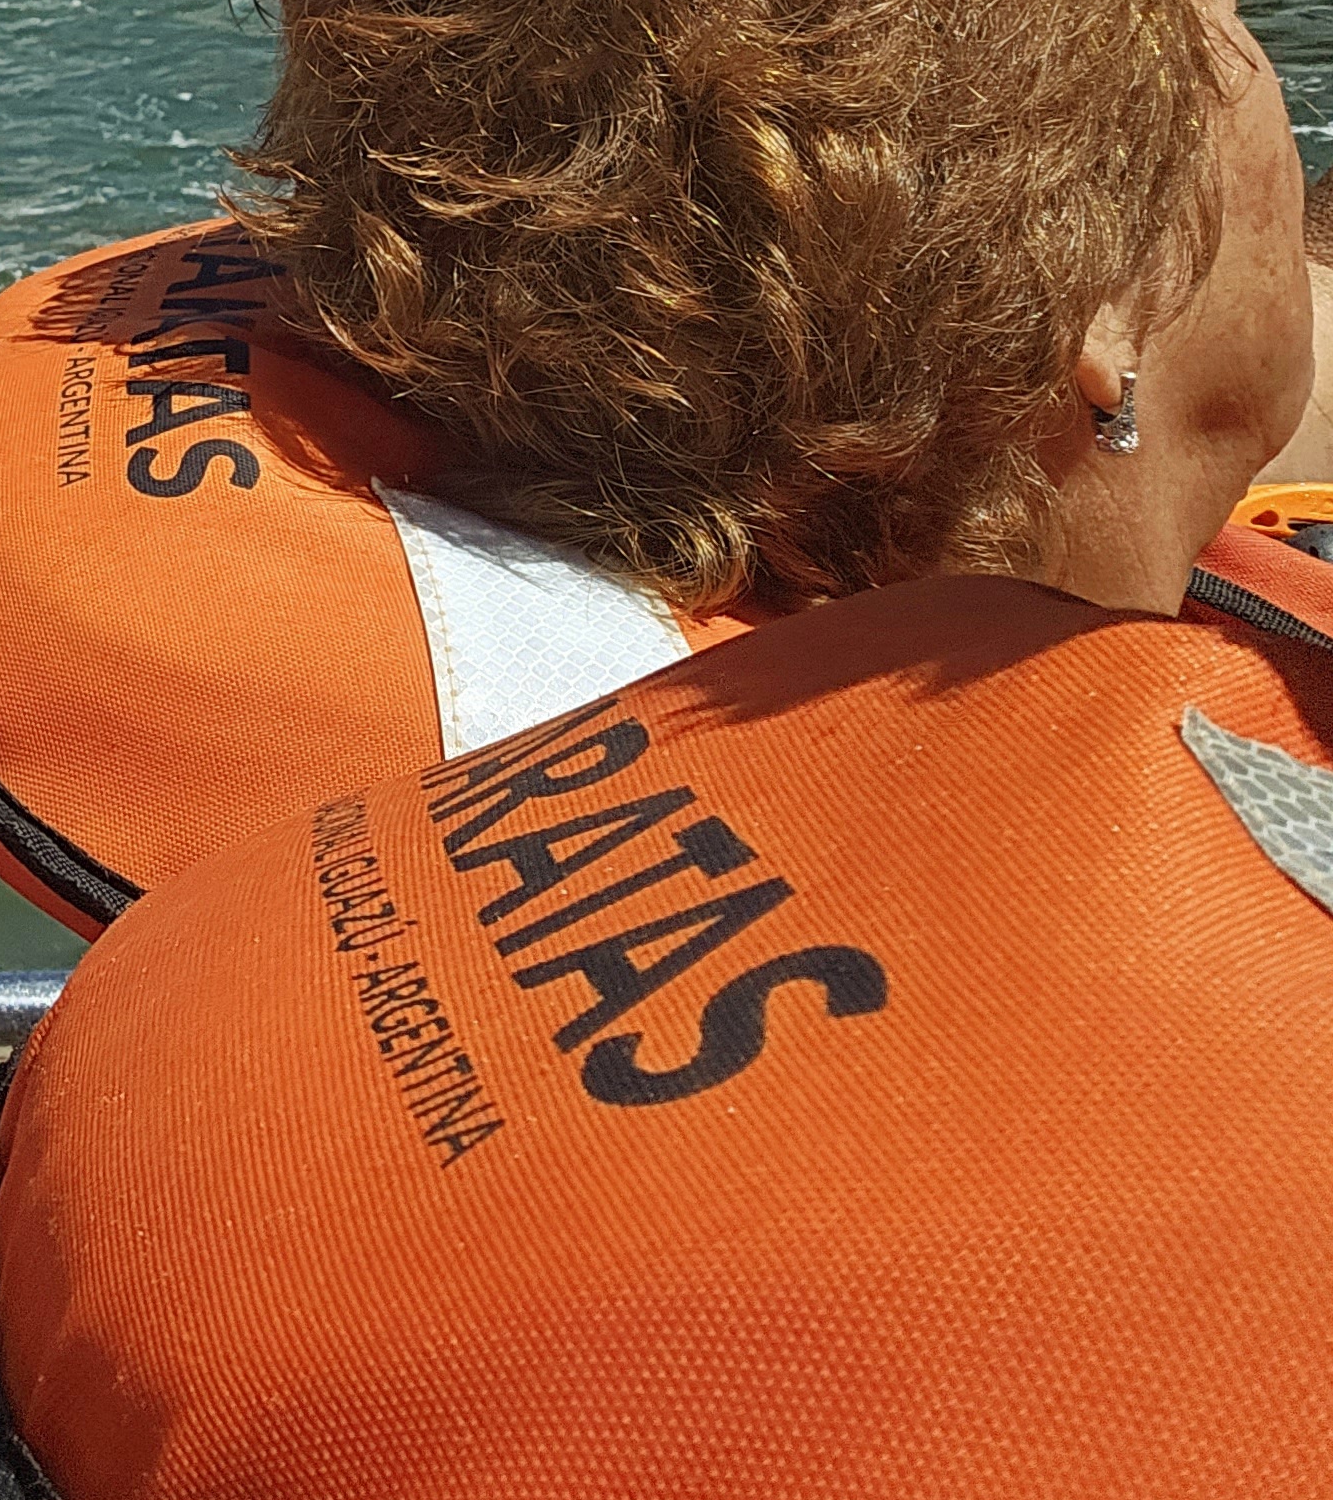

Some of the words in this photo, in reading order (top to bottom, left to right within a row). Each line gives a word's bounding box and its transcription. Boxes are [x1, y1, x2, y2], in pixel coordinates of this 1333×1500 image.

[57, 356, 97, 488] ARGENTINA
[314, 846, 418, 952] IGUAZÚ
[351, 959, 507, 1170] ARGENTINA
